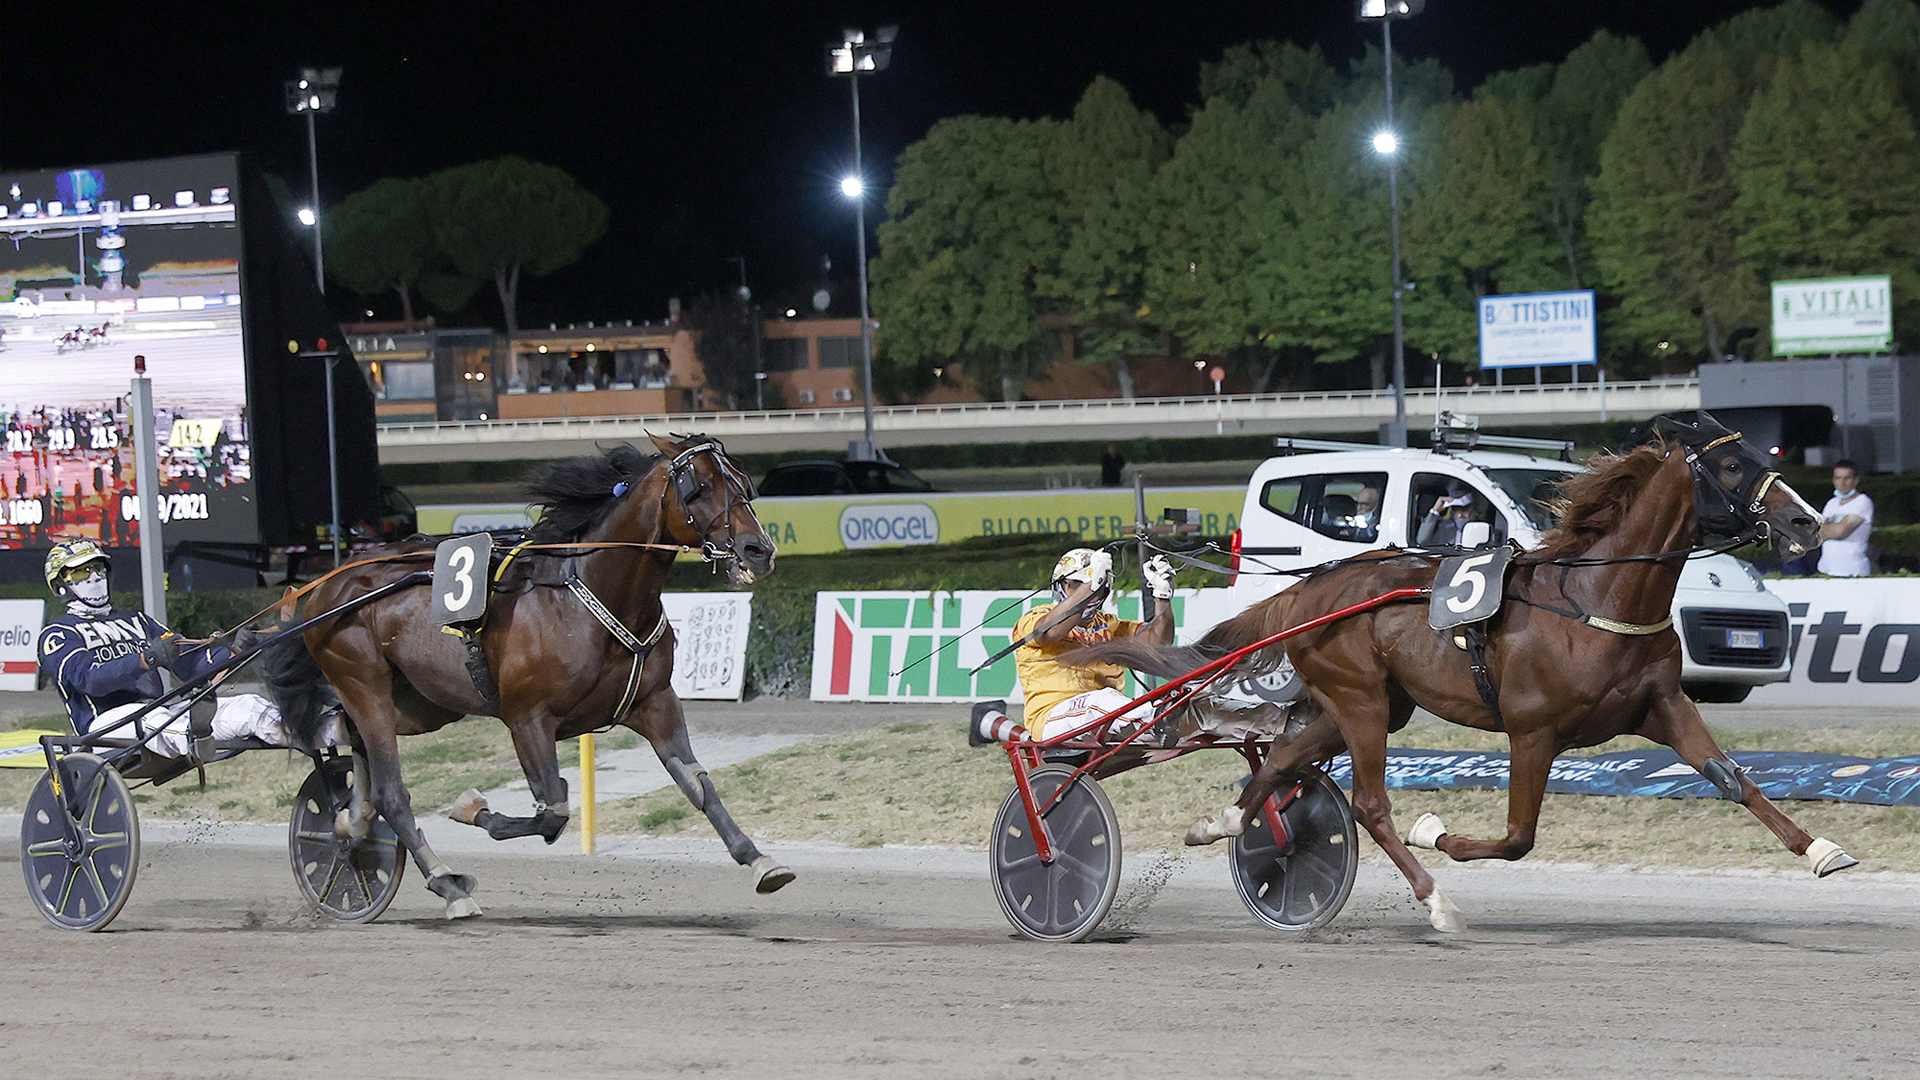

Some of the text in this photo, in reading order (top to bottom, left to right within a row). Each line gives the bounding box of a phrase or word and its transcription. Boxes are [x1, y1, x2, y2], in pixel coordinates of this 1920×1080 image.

[1803, 289, 1884, 309] VITALI
[48, 428, 76, 451] 29.9
[90, 426, 119, 449] 28.5
[9, 499, 43, 525] 1660
[1077, 516, 1123, 539] PER
[444, 546, 475, 612] 3
[1446, 553, 1494, 613] 5
[75, 616, 147, 650] EMV
